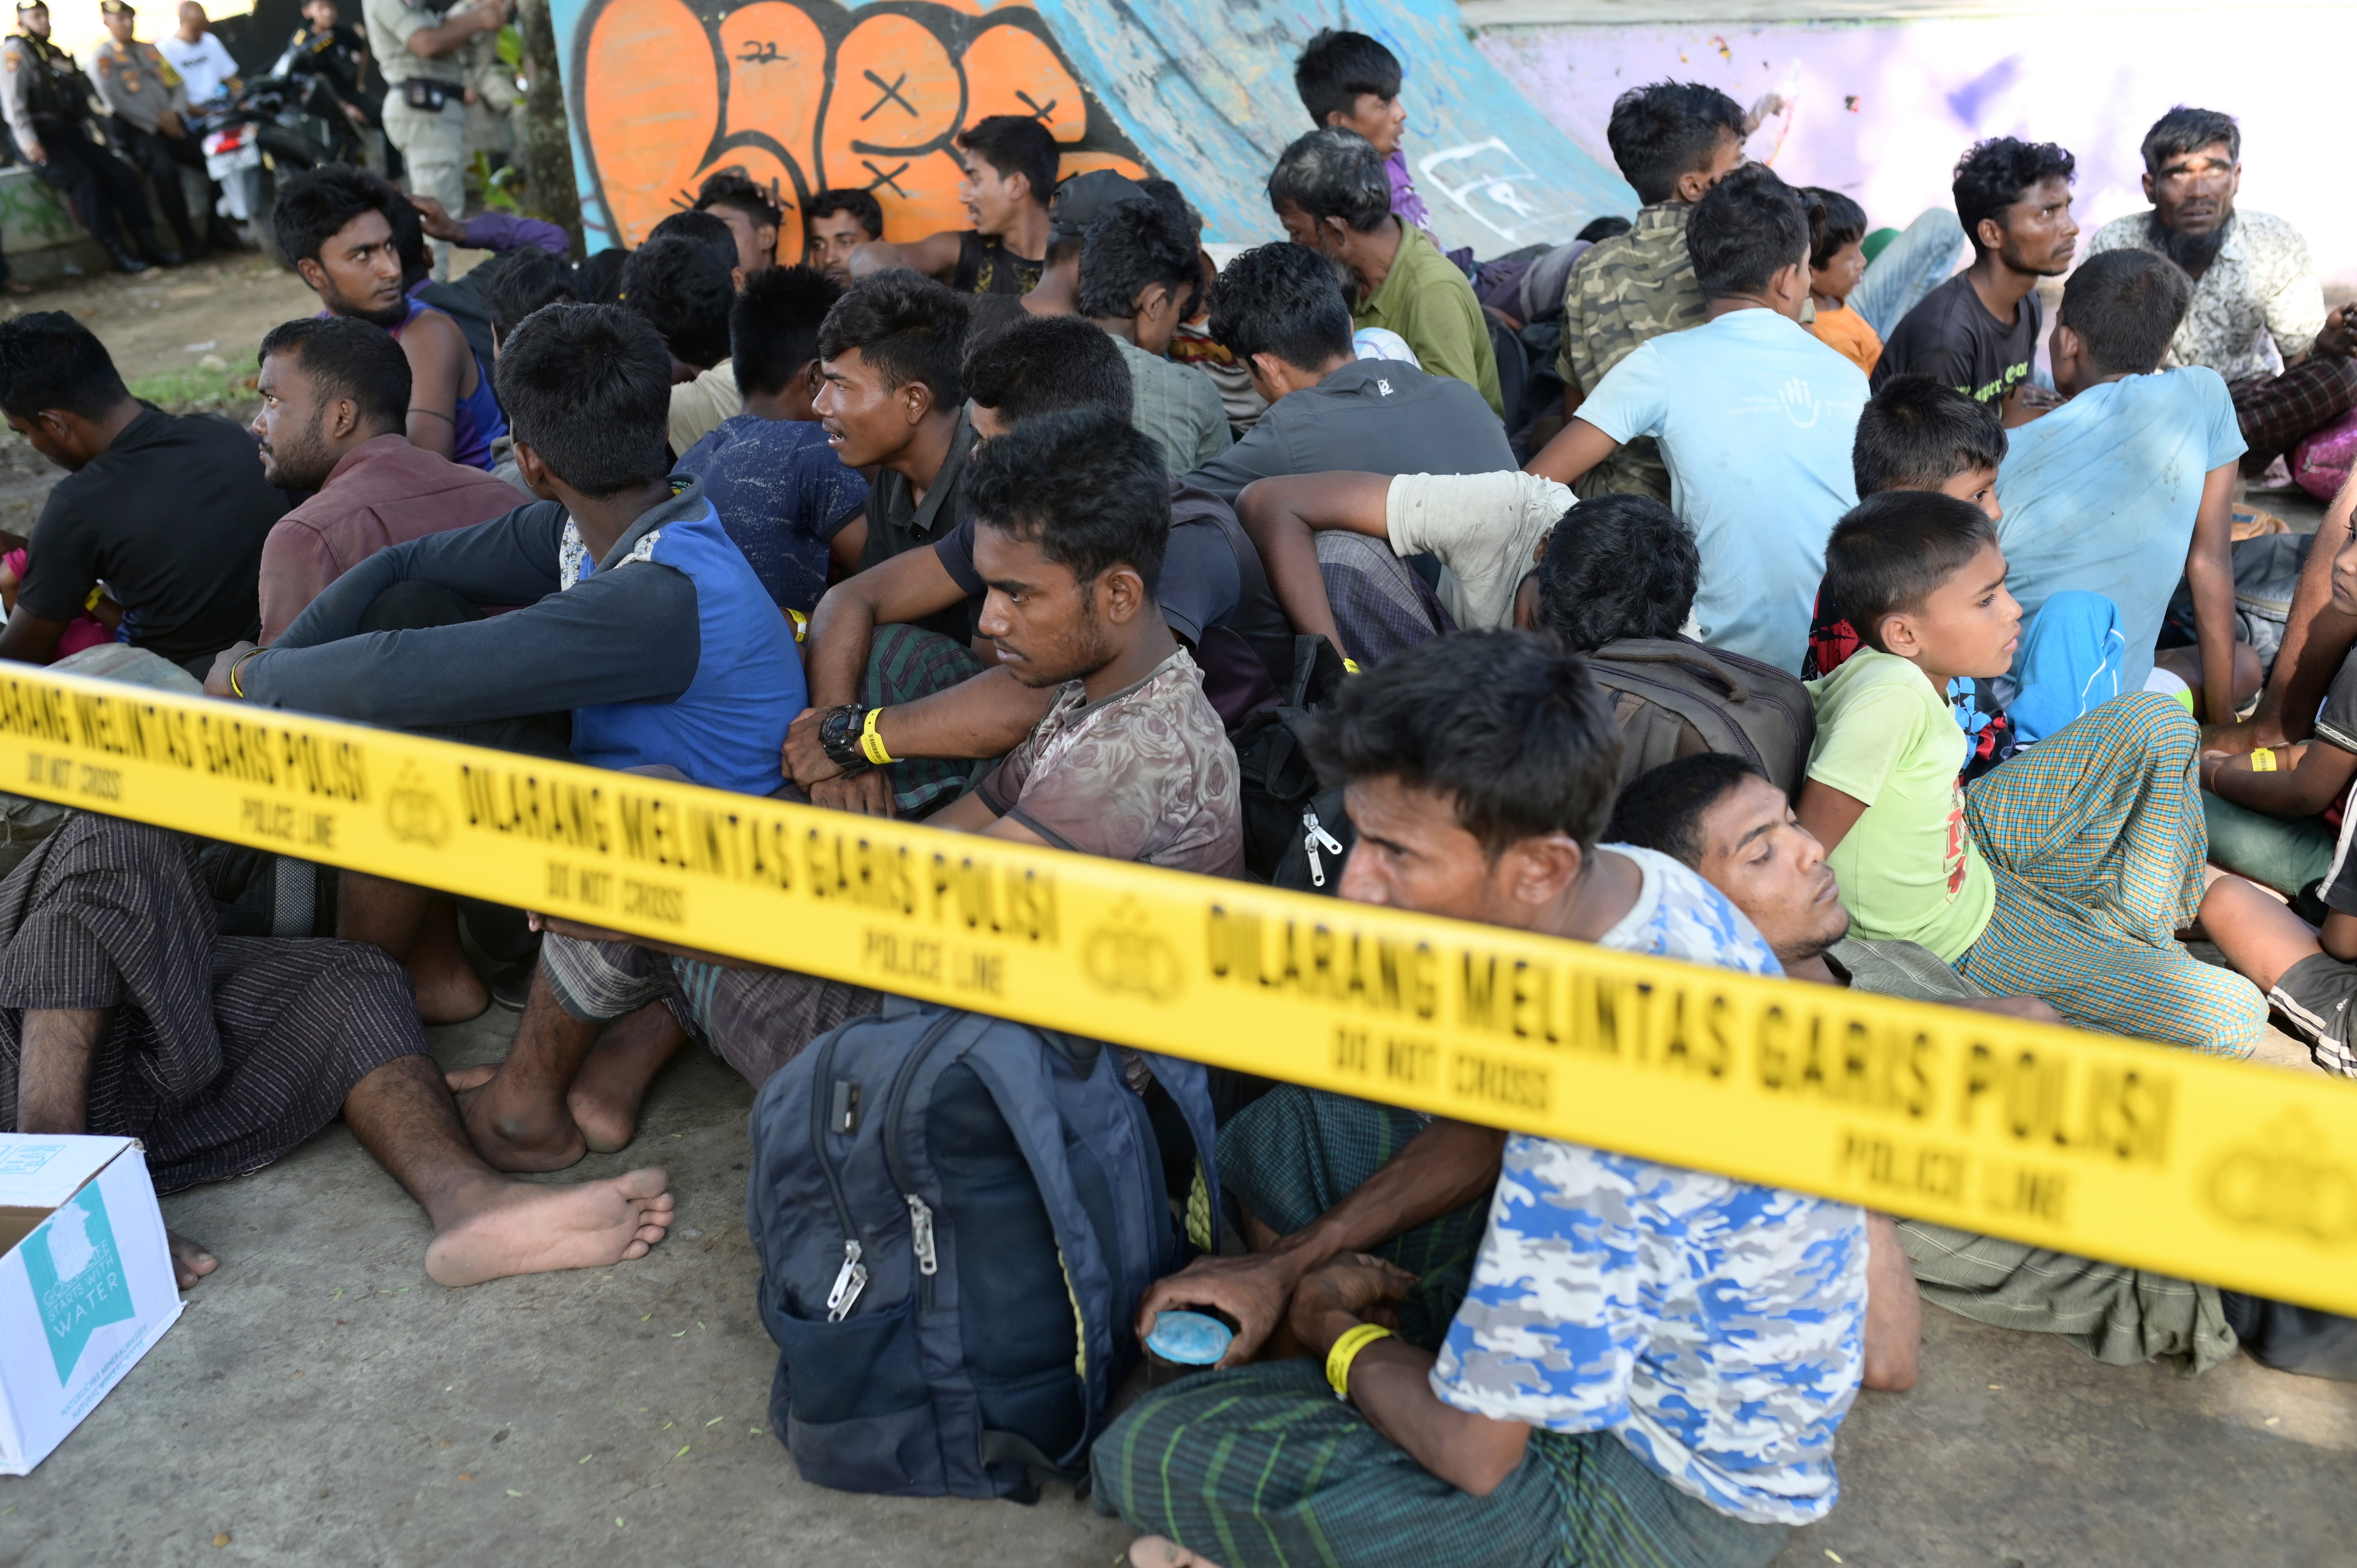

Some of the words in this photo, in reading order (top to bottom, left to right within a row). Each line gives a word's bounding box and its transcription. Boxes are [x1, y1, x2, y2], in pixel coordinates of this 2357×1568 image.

[1785, 376, 1812, 408] Hi
[0, 677, 71, 743] ARANG
[74, 694, 194, 769] MELINTAS
[197, 715, 275, 784] GARIS
[280, 731, 371, 807] POLISI
[458, 764, 609, 853] DILARANG
[618, 794, 792, 890] MELINTAS
[803, 829, 916, 914] GARIS
[929, 852, 1059, 947] POLISI
[624, 879, 686, 925] CROSS
[864, 929, 942, 984] POLICE
[952, 949, 1006, 998] LINE
[1207, 904, 1436, 1019] DILARANG
[1461, 951, 1731, 1080] MELINTAS
[1757, 1005, 1932, 1118] GARIS
[1959, 1044, 2173, 1173] POLISI
[1386, 1037, 1438, 1086] NOT
[1453, 1052, 1550, 1112] CROSS
[1841, 1131, 1965, 1200] POLICE
[1985, 1164, 2069, 1225] LINE
[48, 1283, 84, 1322] STARTS
[84, 1254, 114, 1286] WITH
[53, 1271, 118, 1338] WATER
[72, 1388, 100, 1420] NATURAL
